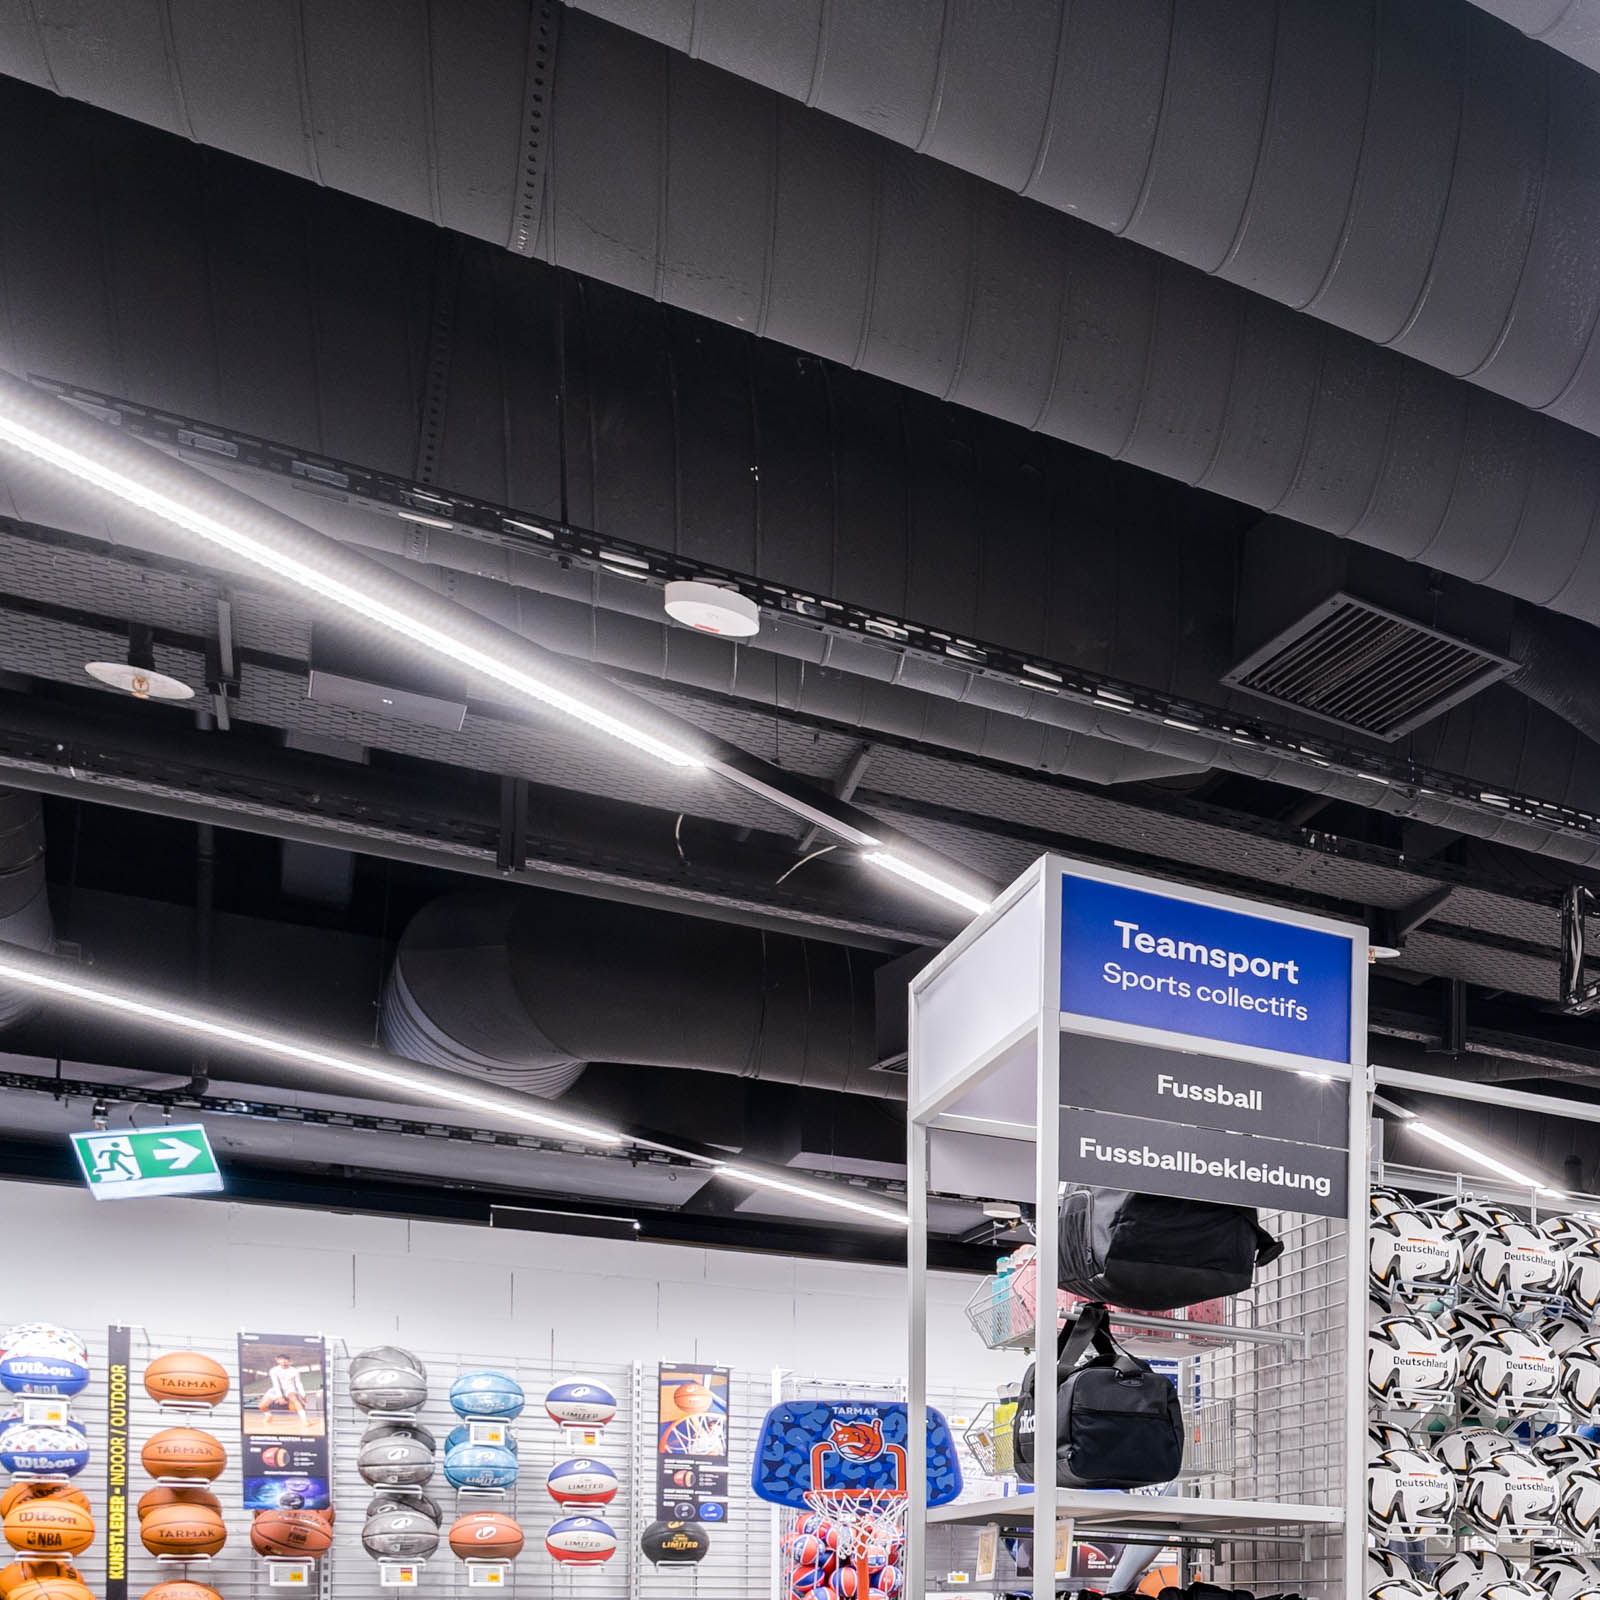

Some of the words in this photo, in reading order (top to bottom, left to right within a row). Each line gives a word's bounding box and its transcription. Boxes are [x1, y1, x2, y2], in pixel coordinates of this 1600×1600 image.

[1114, 920, 1299, 985] Teamsport
[1103, 962, 1191, 998] Sports
[1196, 986, 1308, 1021] collectifs
[1157, 1073, 1263, 1111] Fussball
[1079, 1136, 1331, 1197] Fussballbekleidung
[1394, 1242, 1449, 1258] Deutschland
[1504, 1251, 1556, 1268] Deutschland
[9, 1361, 73, 1378] Wilson
[1393, 1356, 1448, 1370] Deutschland
[1506, 1361, 1555, 1375] Deutschland
[160, 1378, 217, 1389] TARMAK
[111, 1364, 127, 1427] OUTDOOR
[832, 1406, 879, 1416] TARMAK
[13, 1455, 76, 1469] Wilson
[110, 1436, 126, 1486] INDOOR
[1395, 1479, 1449, 1491] Deutschland
[1505, 1482, 1554, 1494] Deutschland
[18, 1511, 77, 1526] Wilson
[37, 1533, 62, 1546] NBA
[109, 1496, 126, 1579] KUNSTLEDER
[158, 1528, 216, 1538] TARMAK
[662, 1541, 699, 1550] LIMITED
